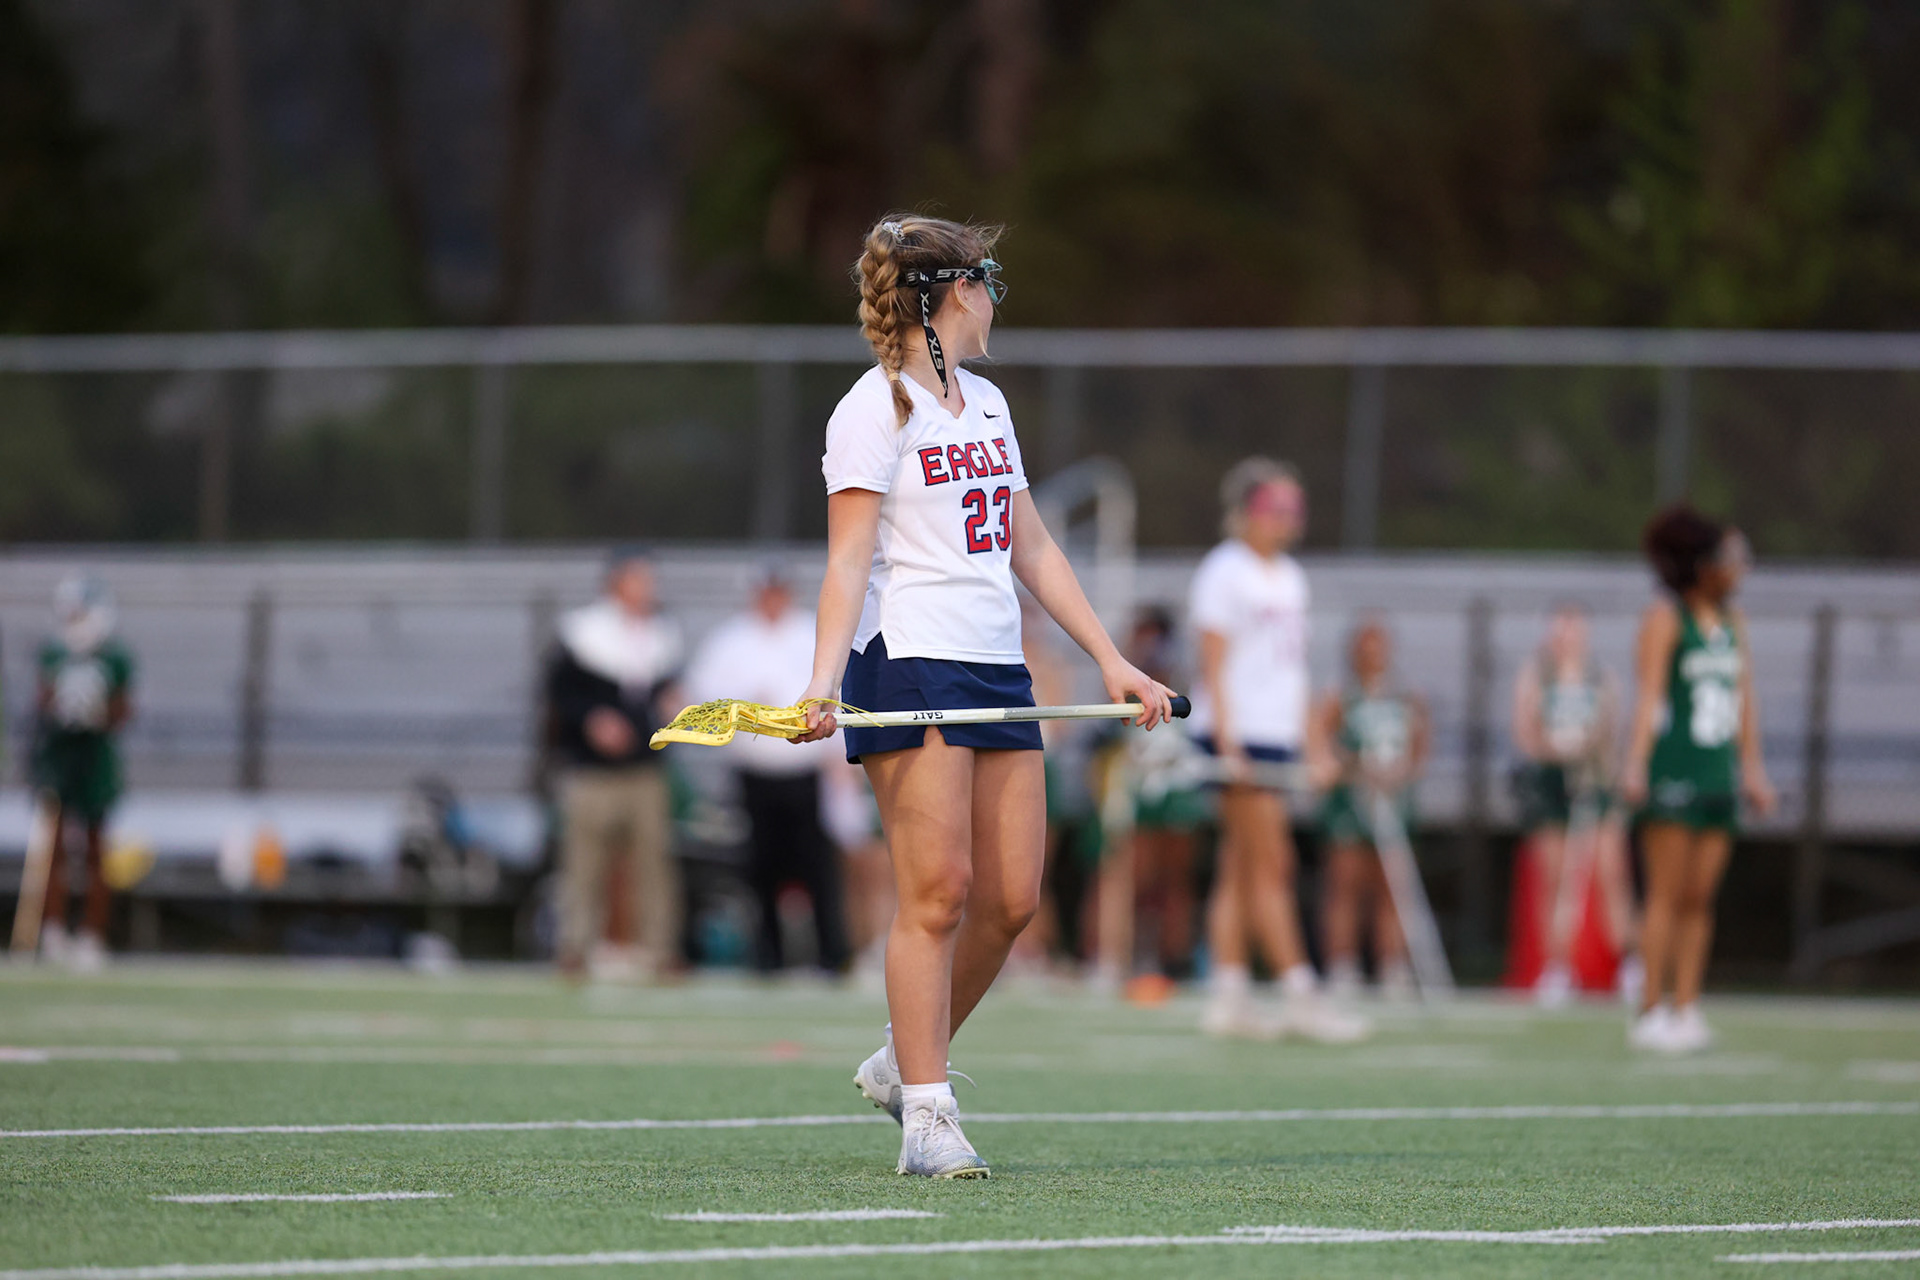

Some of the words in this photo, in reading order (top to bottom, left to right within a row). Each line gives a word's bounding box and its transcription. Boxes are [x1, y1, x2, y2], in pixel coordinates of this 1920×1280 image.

[936, 268, 975, 279] STX
[928, 336, 944, 370] STX
[917, 438, 1013, 486] EAGLE
[962, 486, 1011, 554] 23
